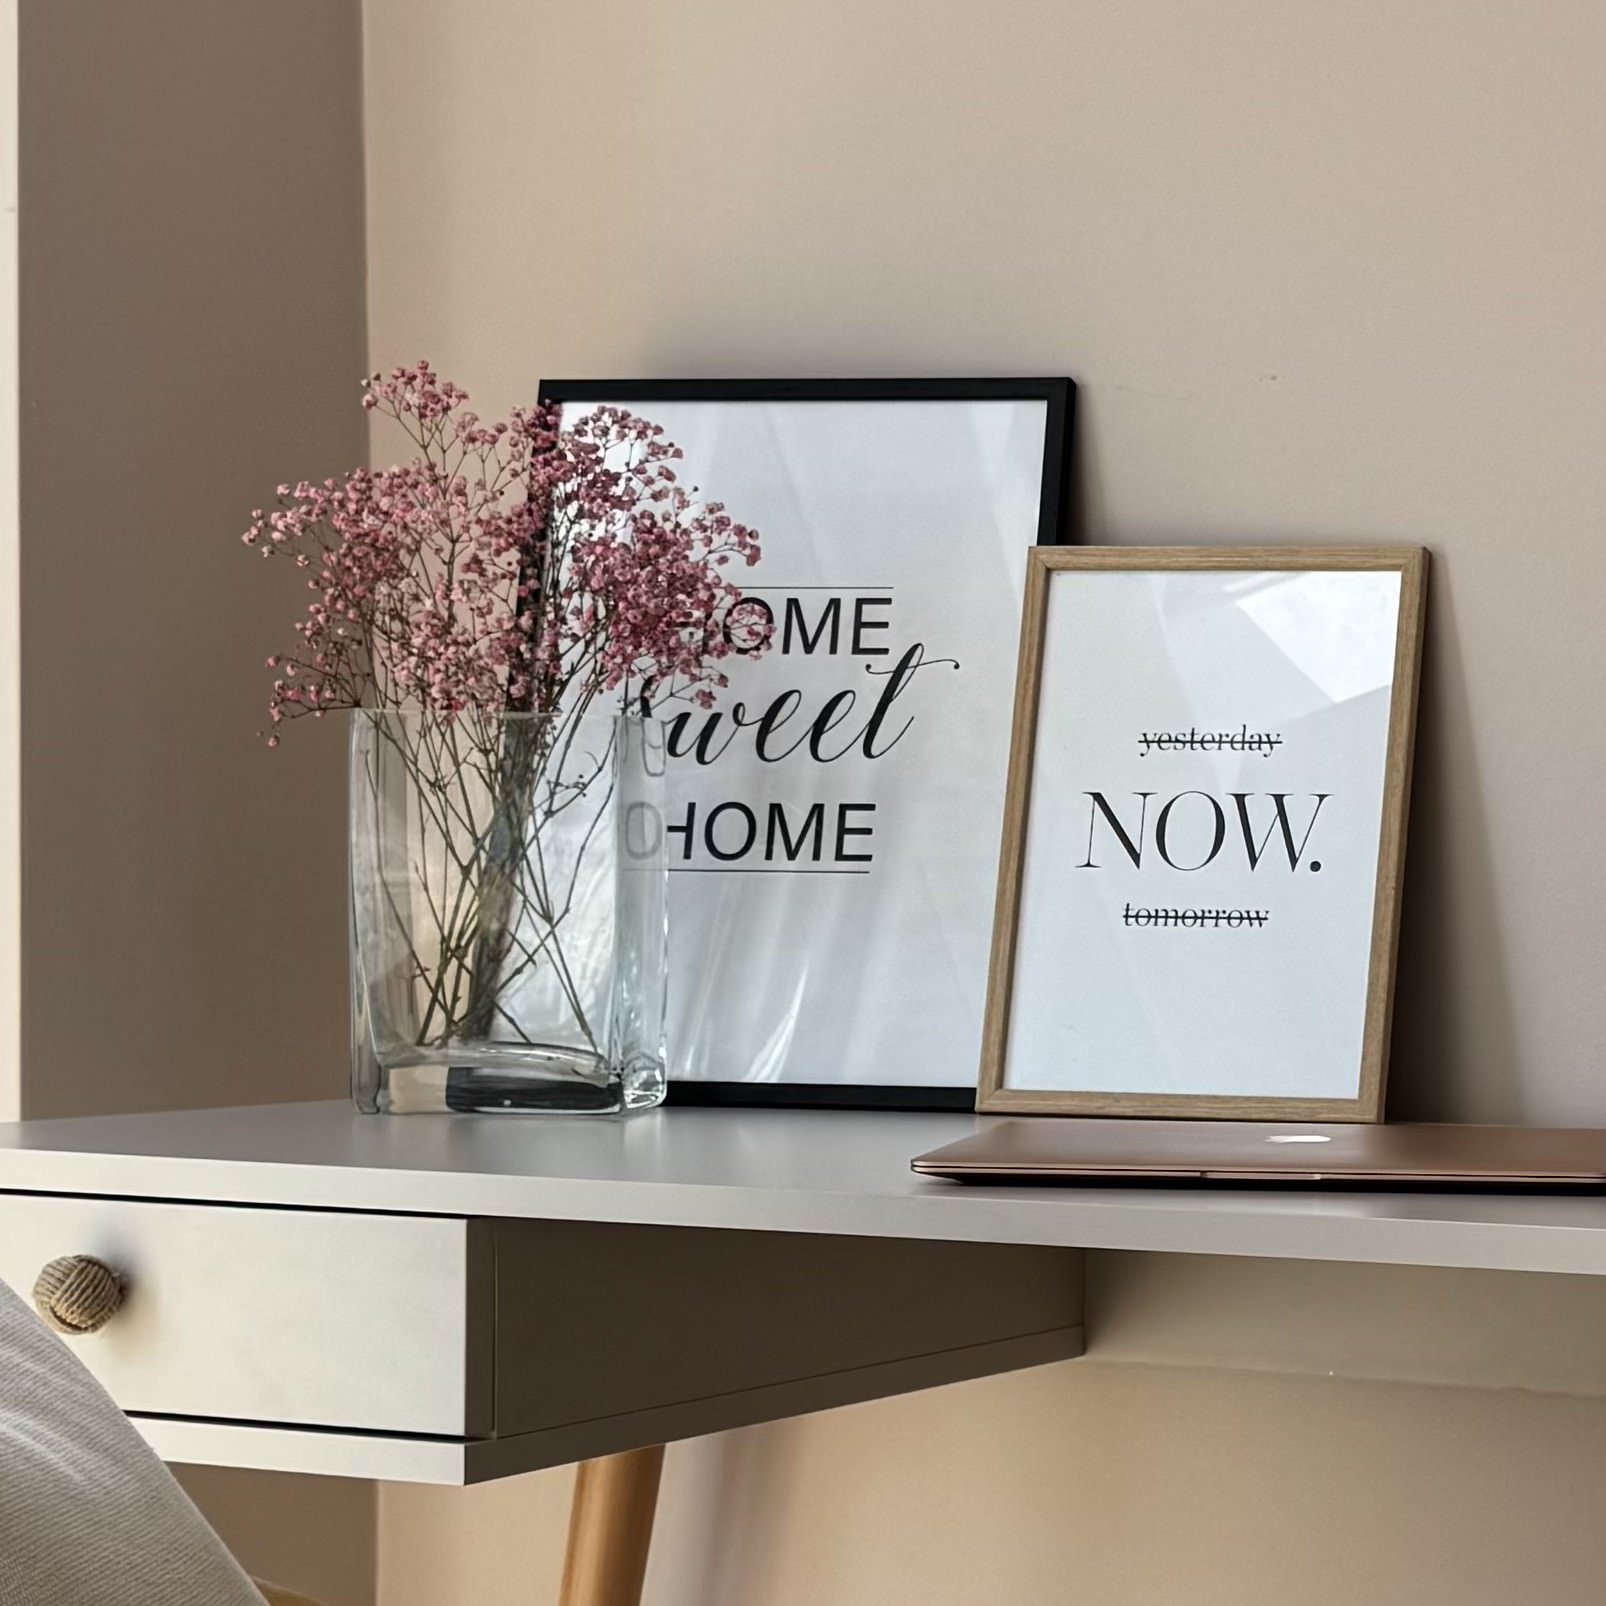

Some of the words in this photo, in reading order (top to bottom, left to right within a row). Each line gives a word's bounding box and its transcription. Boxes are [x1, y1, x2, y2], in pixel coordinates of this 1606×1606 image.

[1137, 723, 1284, 758] yesterday
[1074, 790, 1334, 873] NOW.
[1122, 902, 1270, 929] tomorrow
